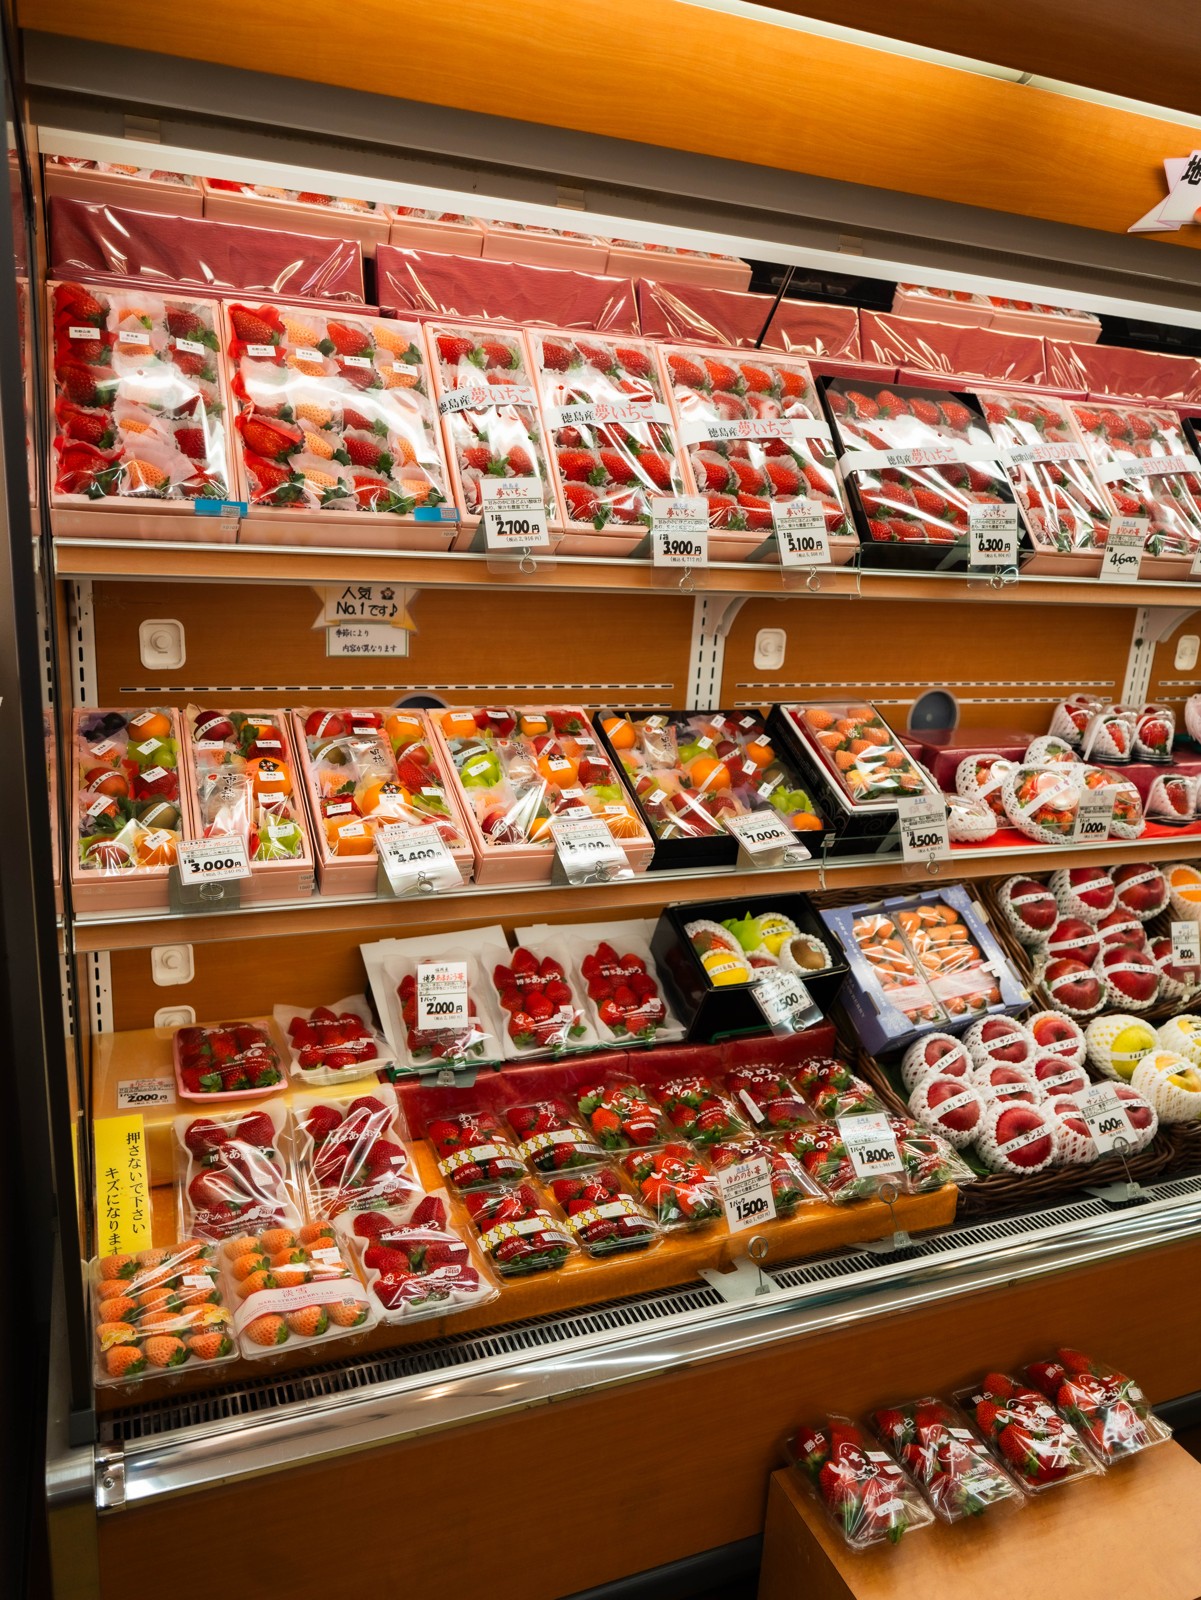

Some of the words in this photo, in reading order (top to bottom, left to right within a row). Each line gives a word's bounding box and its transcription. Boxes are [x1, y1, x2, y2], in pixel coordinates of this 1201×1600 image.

[342, 586, 372, 600] 人気
[191, 858, 241, 873] 3,000円
[427, 1002, 463, 1015] 2,000円
[126, 1132, 146, 1234] 押さないで下さい
[104, 1167, 122, 1256] キズになります
